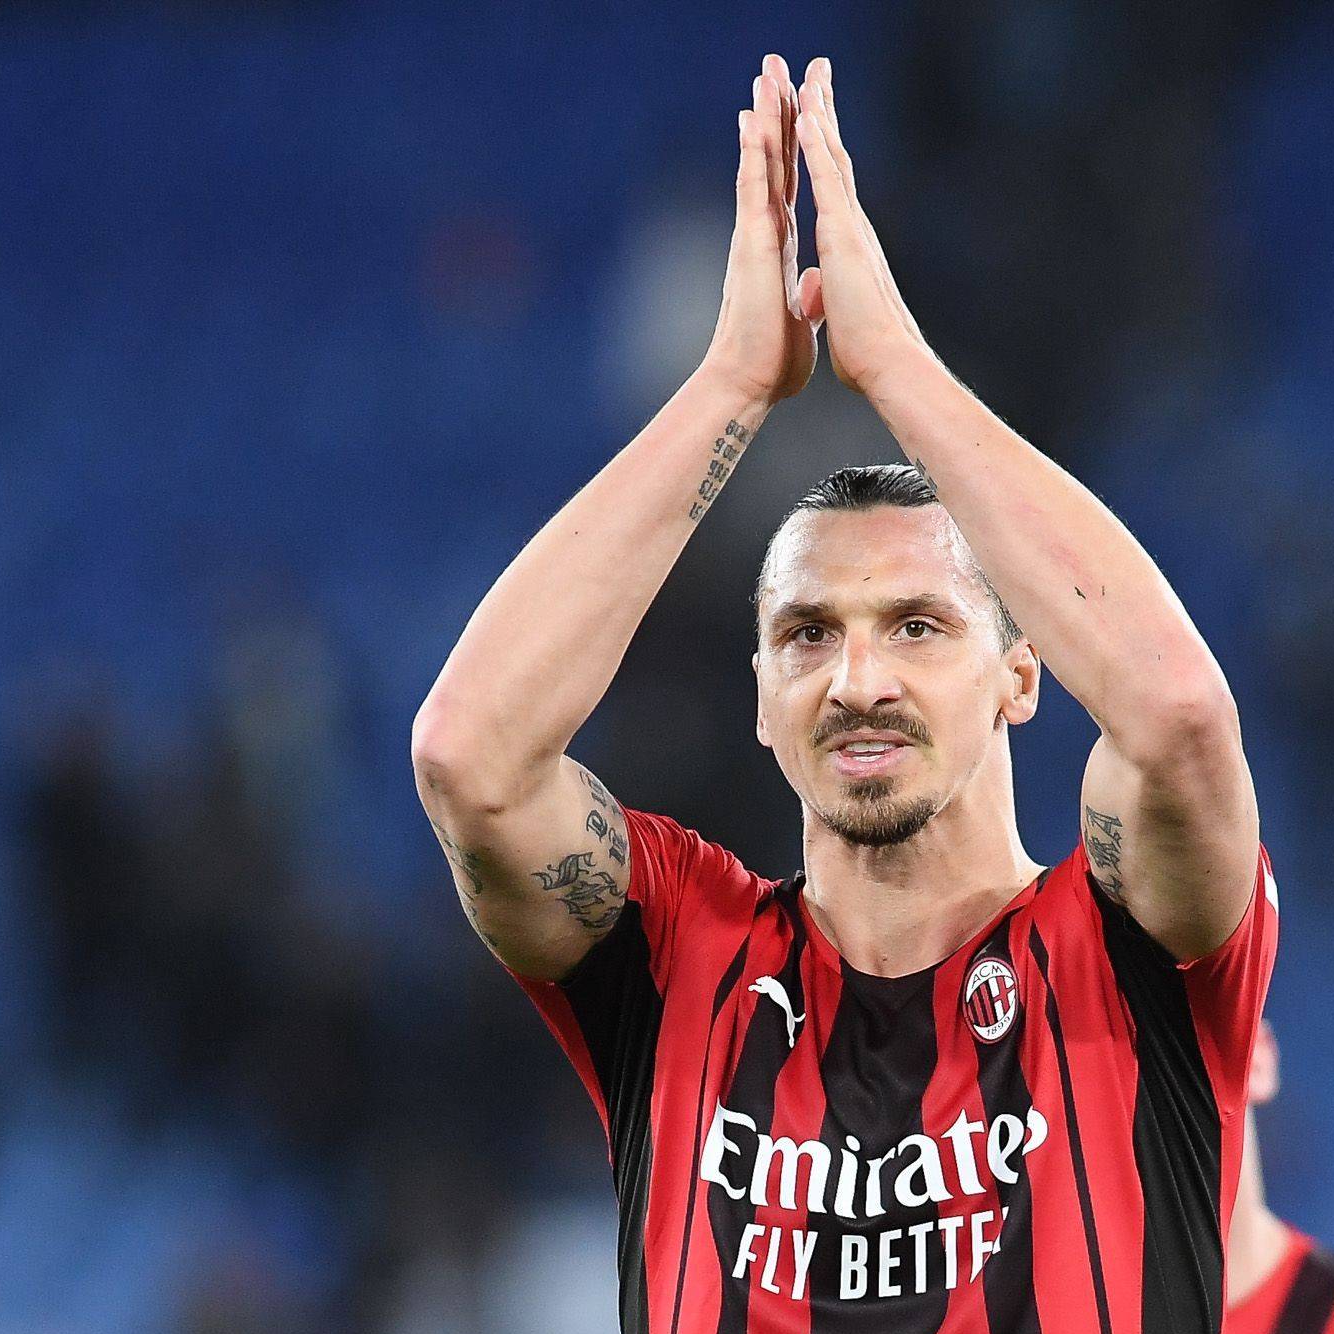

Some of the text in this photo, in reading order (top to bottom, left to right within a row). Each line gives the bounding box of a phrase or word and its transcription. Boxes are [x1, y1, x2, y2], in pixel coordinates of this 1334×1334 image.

[971, 965, 1003, 989] ACM
[987, 1016, 1011, 1036] 1899
[731, 1223, 818, 1300] FLY
